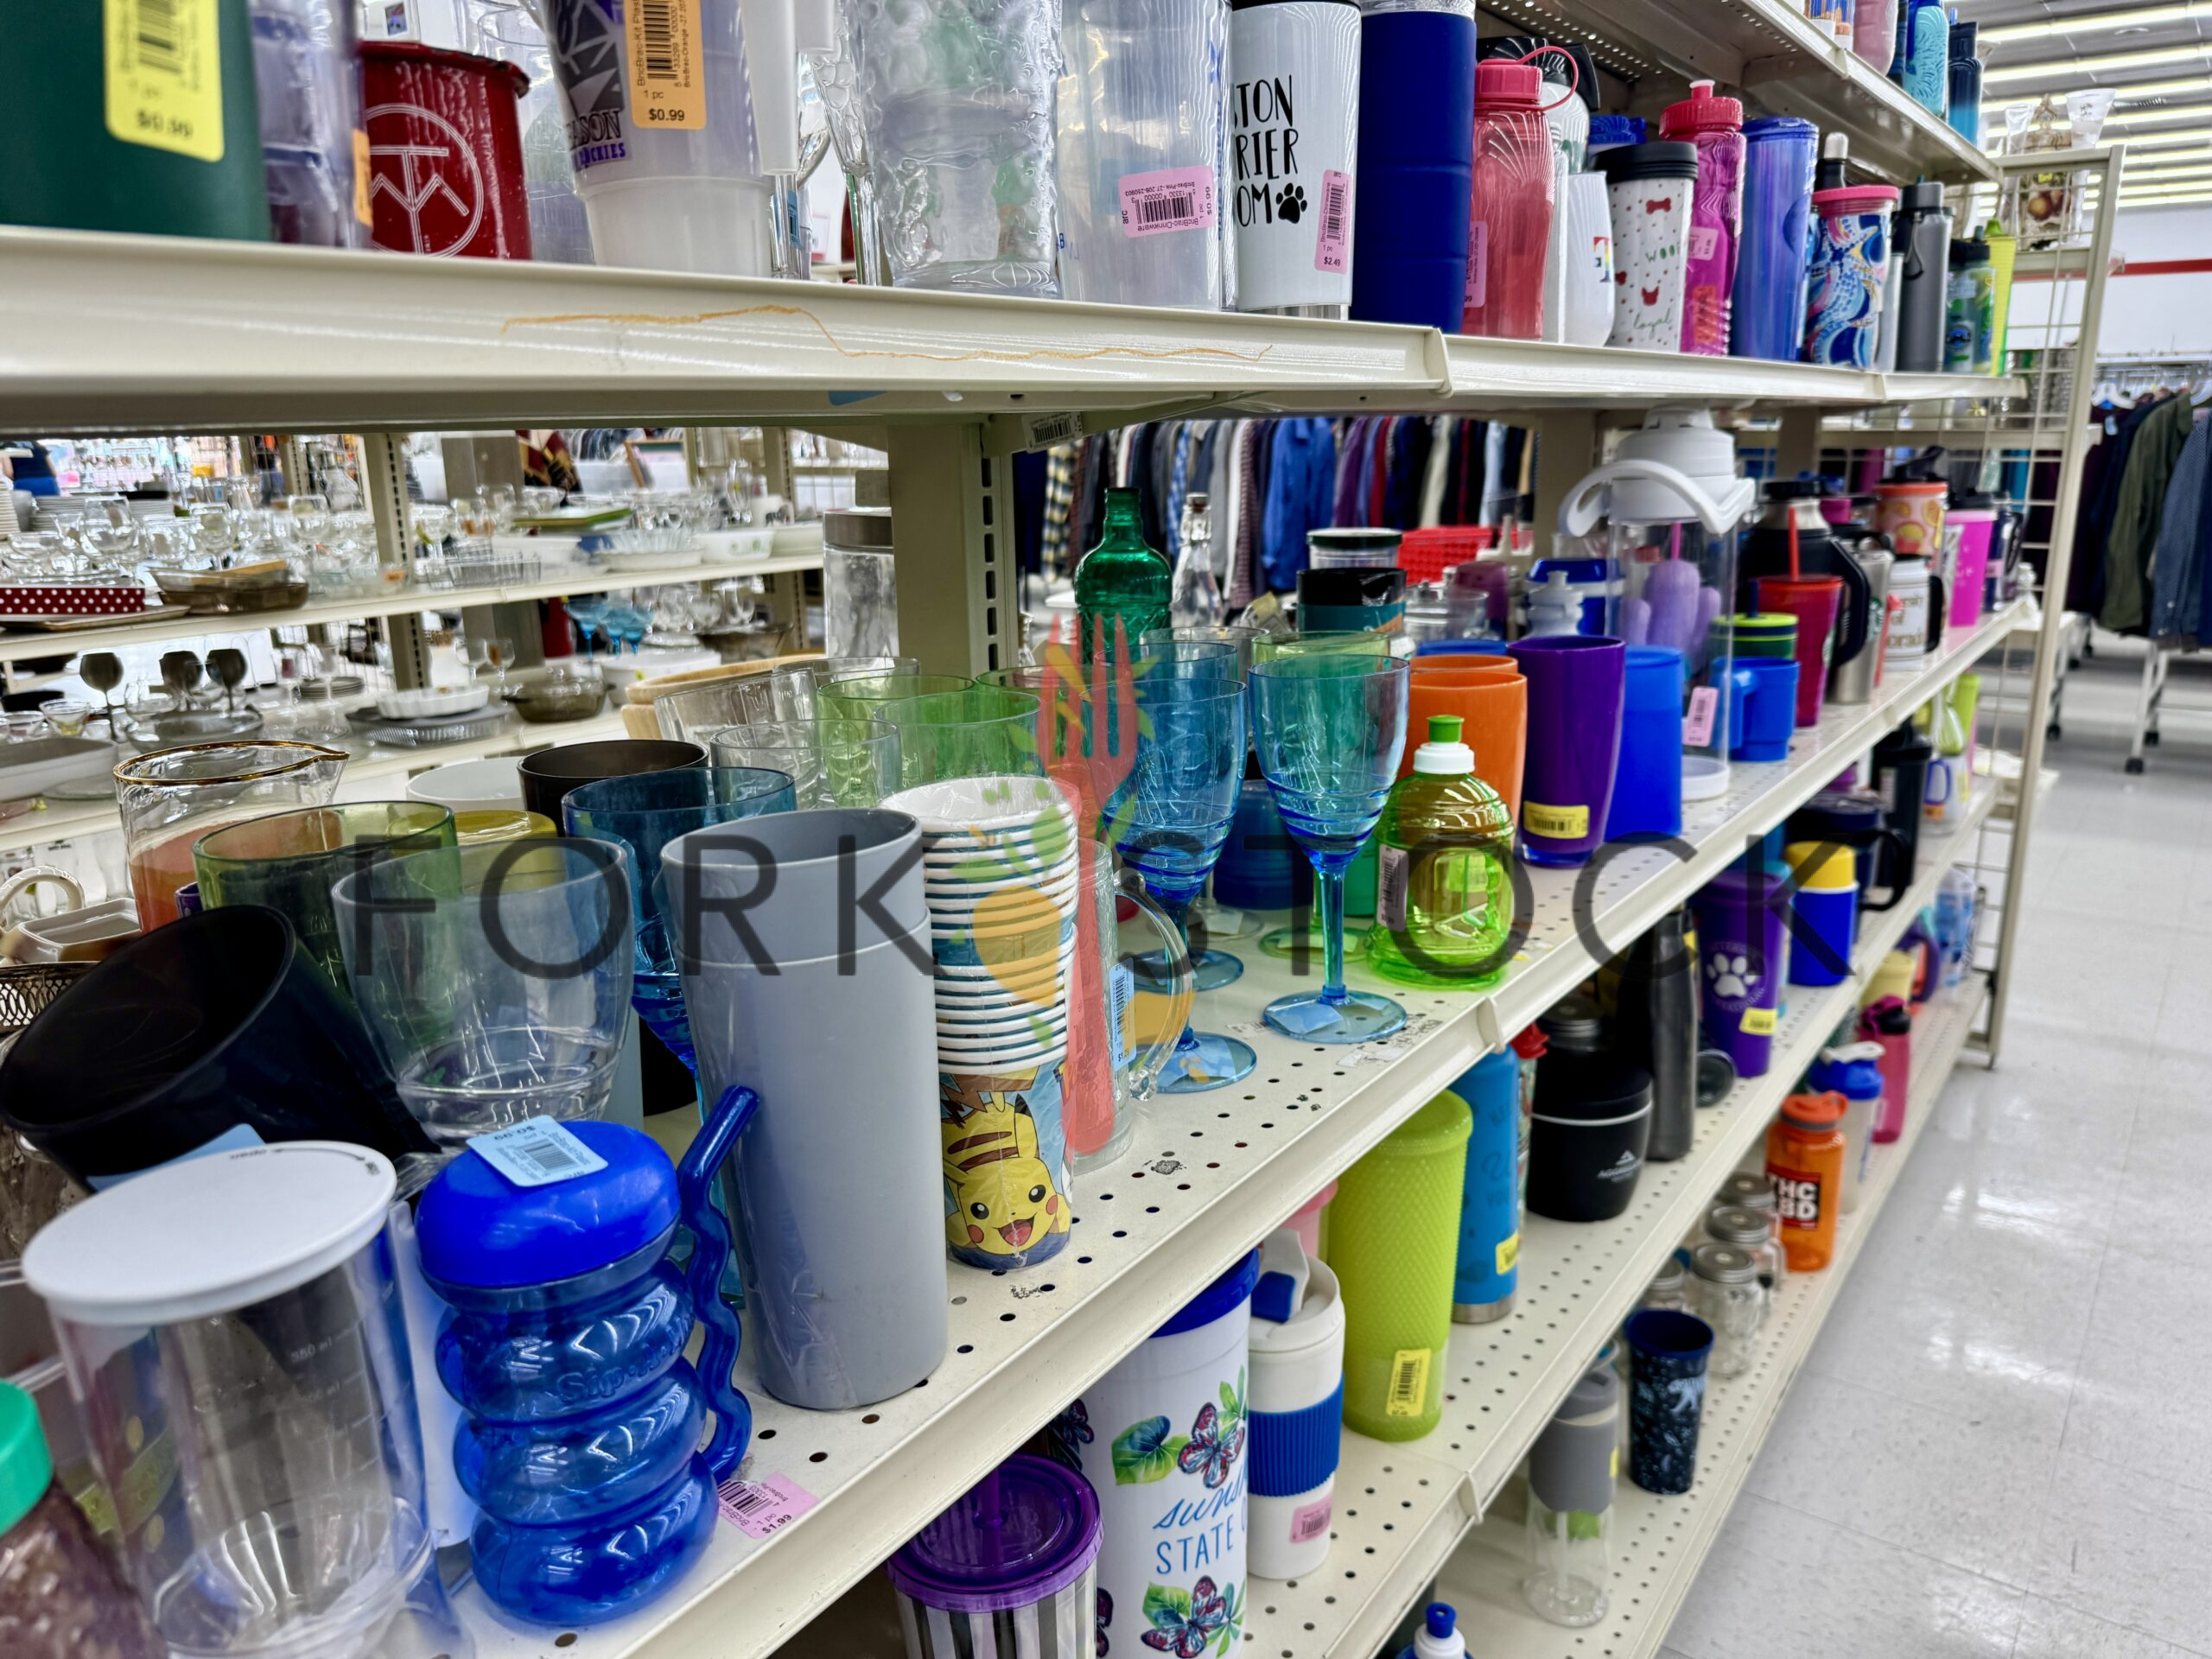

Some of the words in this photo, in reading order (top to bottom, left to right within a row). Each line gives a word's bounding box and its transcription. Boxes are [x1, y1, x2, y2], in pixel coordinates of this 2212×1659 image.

[648, 107, 686, 122] $0.99
[1323, 256, 1341, 267] $2.49
[761, 1514, 792, 1534] $1.99
[1155, 1514, 1234, 1574] STATE
